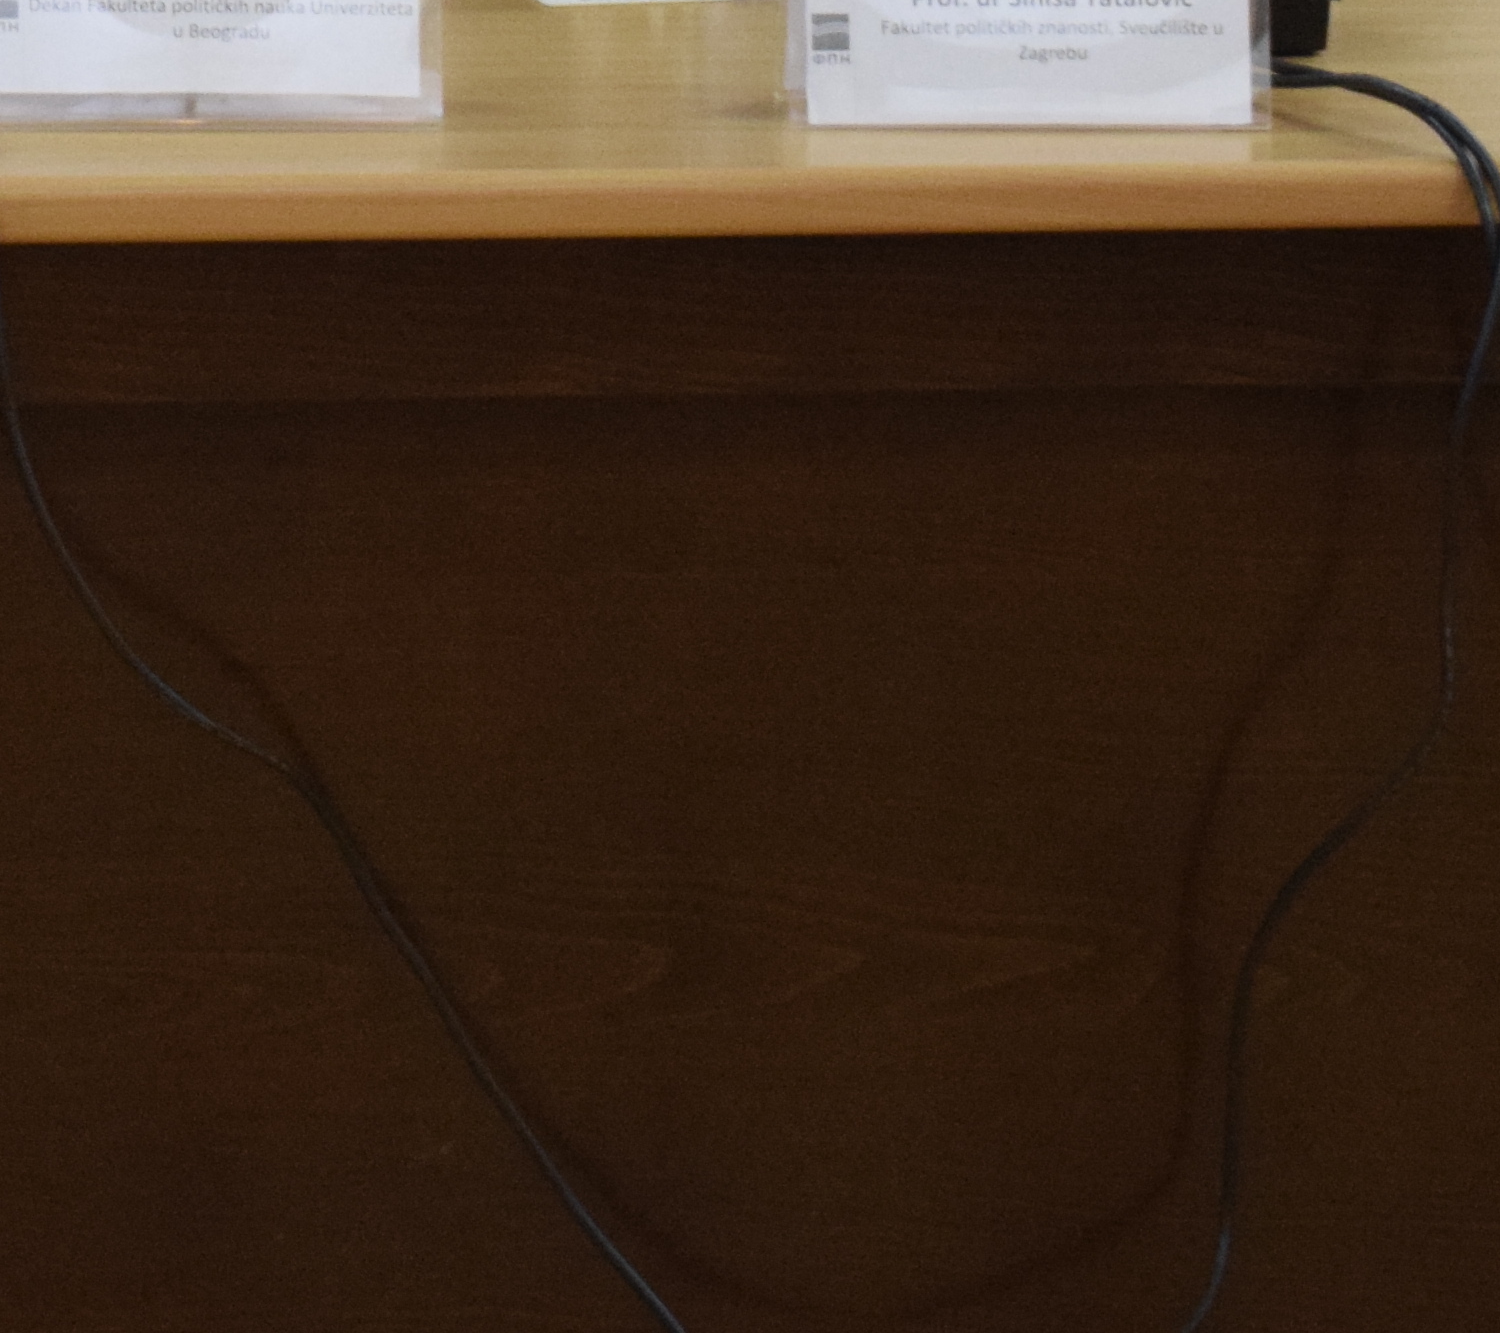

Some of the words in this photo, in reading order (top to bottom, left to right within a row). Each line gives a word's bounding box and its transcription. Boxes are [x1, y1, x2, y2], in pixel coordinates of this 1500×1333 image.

[310, 0, 413, 17] Univerziteta
[189, 24, 270, 44] Beogradu
[880, 19, 950, 35] Fakultet
[955, 19, 1032, 38] političkih
[1119, 18, 1208, 36] Sveučilište
[1018, 45, 1088, 65] Zagrebu
